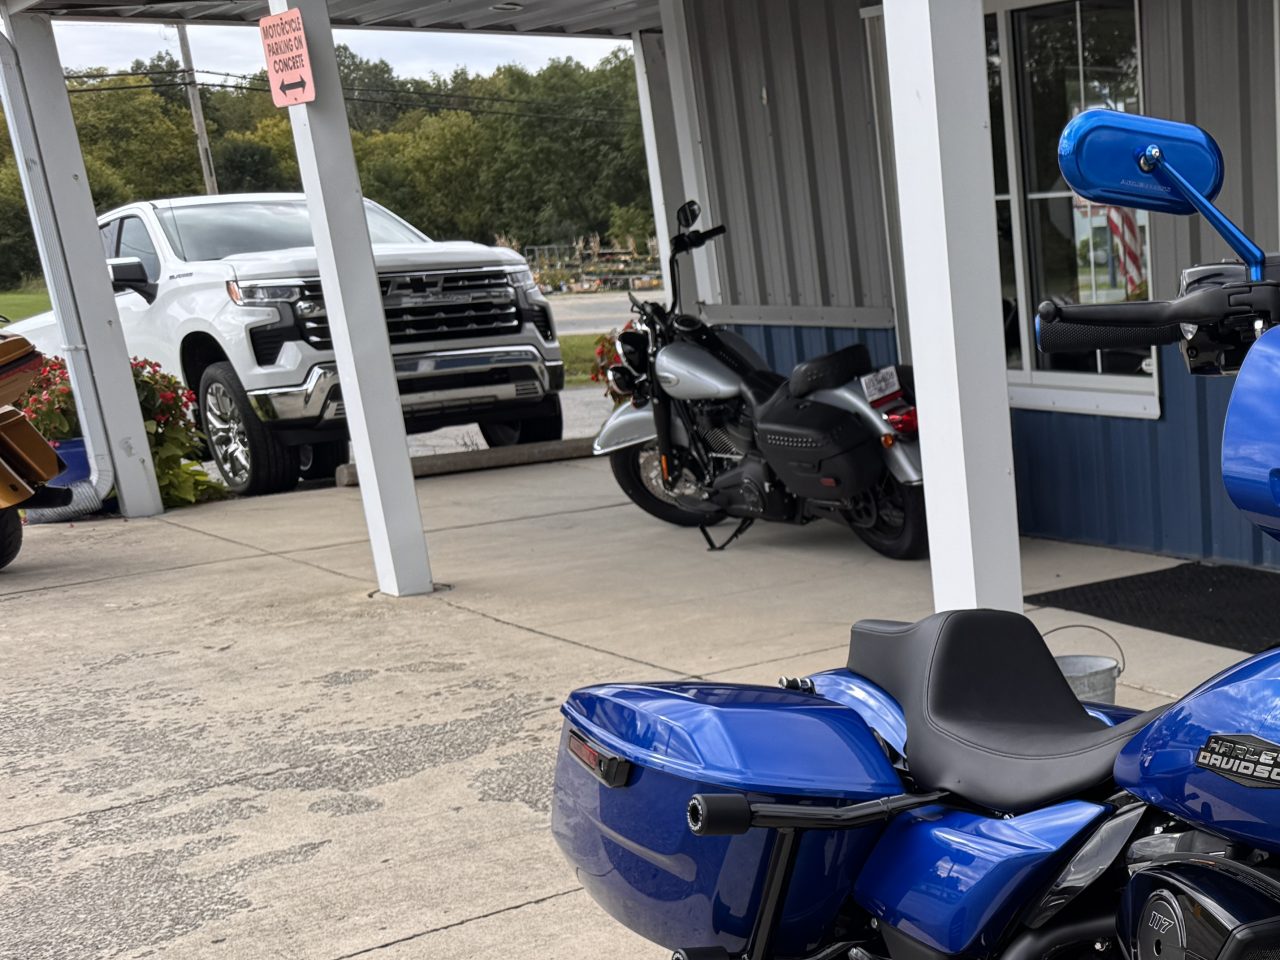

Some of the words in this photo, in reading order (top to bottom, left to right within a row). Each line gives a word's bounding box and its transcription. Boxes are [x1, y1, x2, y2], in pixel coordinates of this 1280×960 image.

[262, 17, 301, 40] MOTORCYCLE
[267, 39, 293, 57] PARKING
[294, 35, 304, 50] ON
[273, 54, 304, 73] CONCRETE
[1149, 911, 1175, 933] 117
